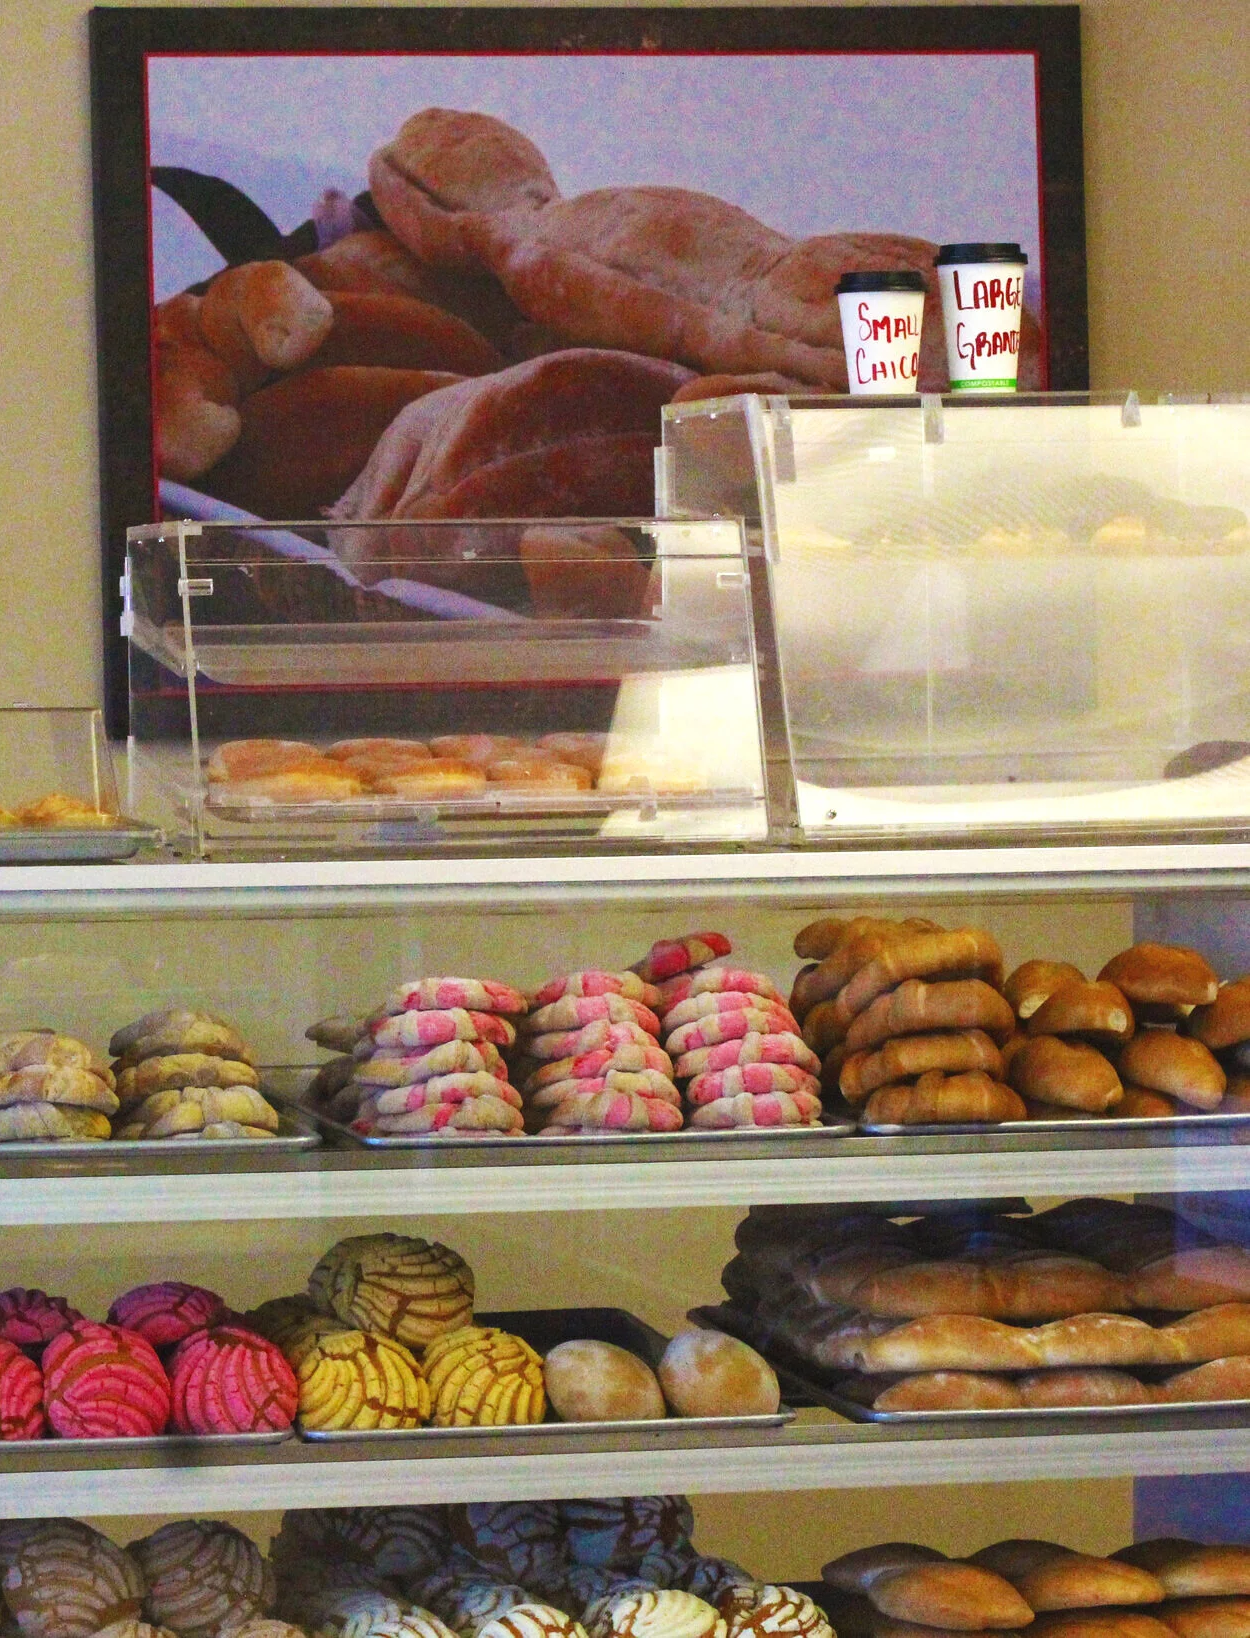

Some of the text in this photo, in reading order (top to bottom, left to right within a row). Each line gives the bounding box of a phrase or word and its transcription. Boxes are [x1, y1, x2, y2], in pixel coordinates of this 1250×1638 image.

[953, 270, 1021, 310] LARGE
[858, 302, 919, 344] SMALL
[856, 347, 918, 385] CHICO
